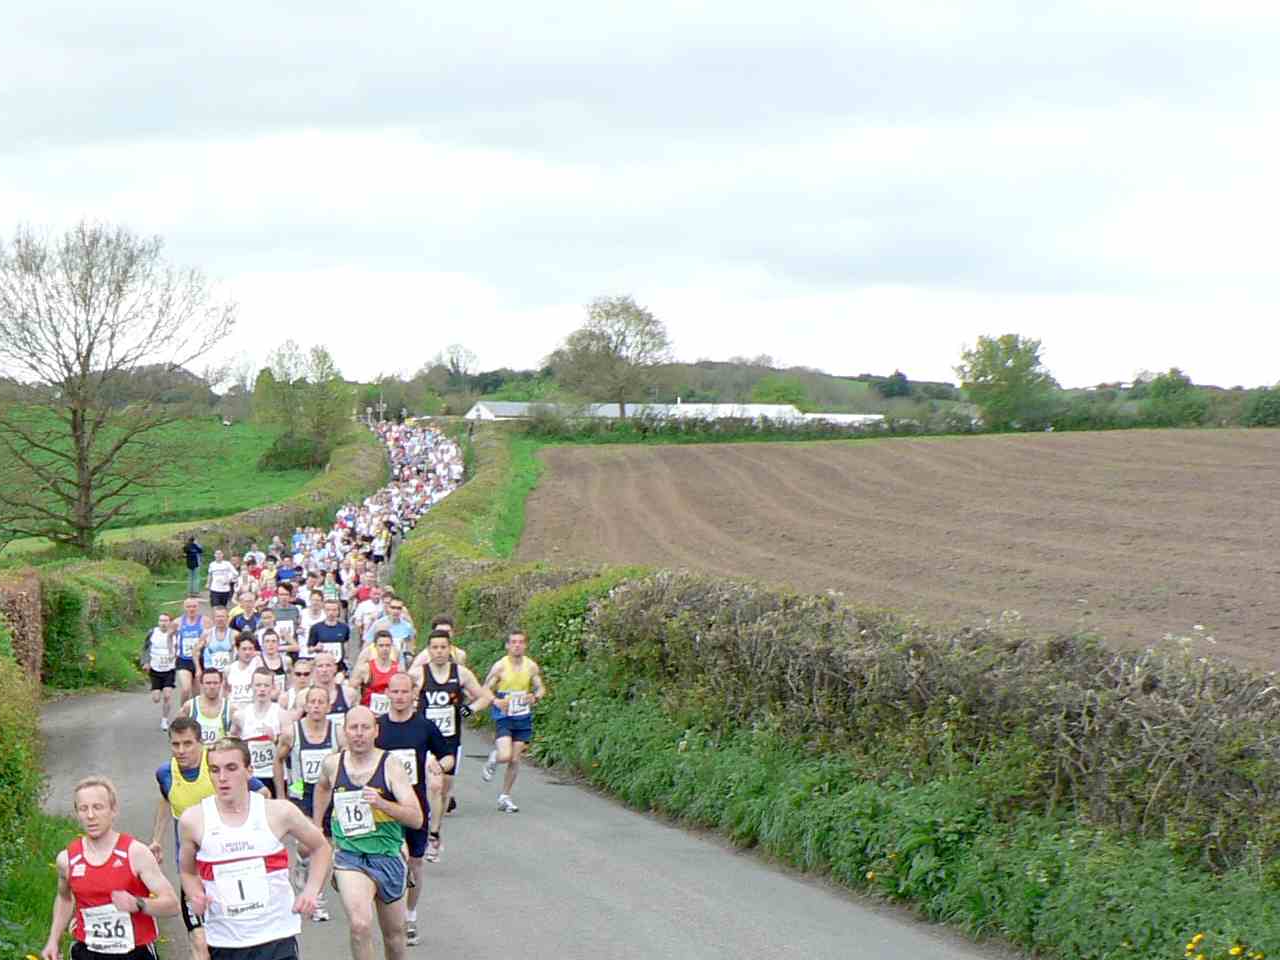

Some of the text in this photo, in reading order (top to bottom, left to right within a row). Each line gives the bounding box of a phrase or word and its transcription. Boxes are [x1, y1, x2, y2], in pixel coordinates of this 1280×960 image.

[251, 748, 274, 763] 263
[345, 804, 363, 823] 16
[237, 879, 245, 901] 1
[92, 918, 125, 939] 256
